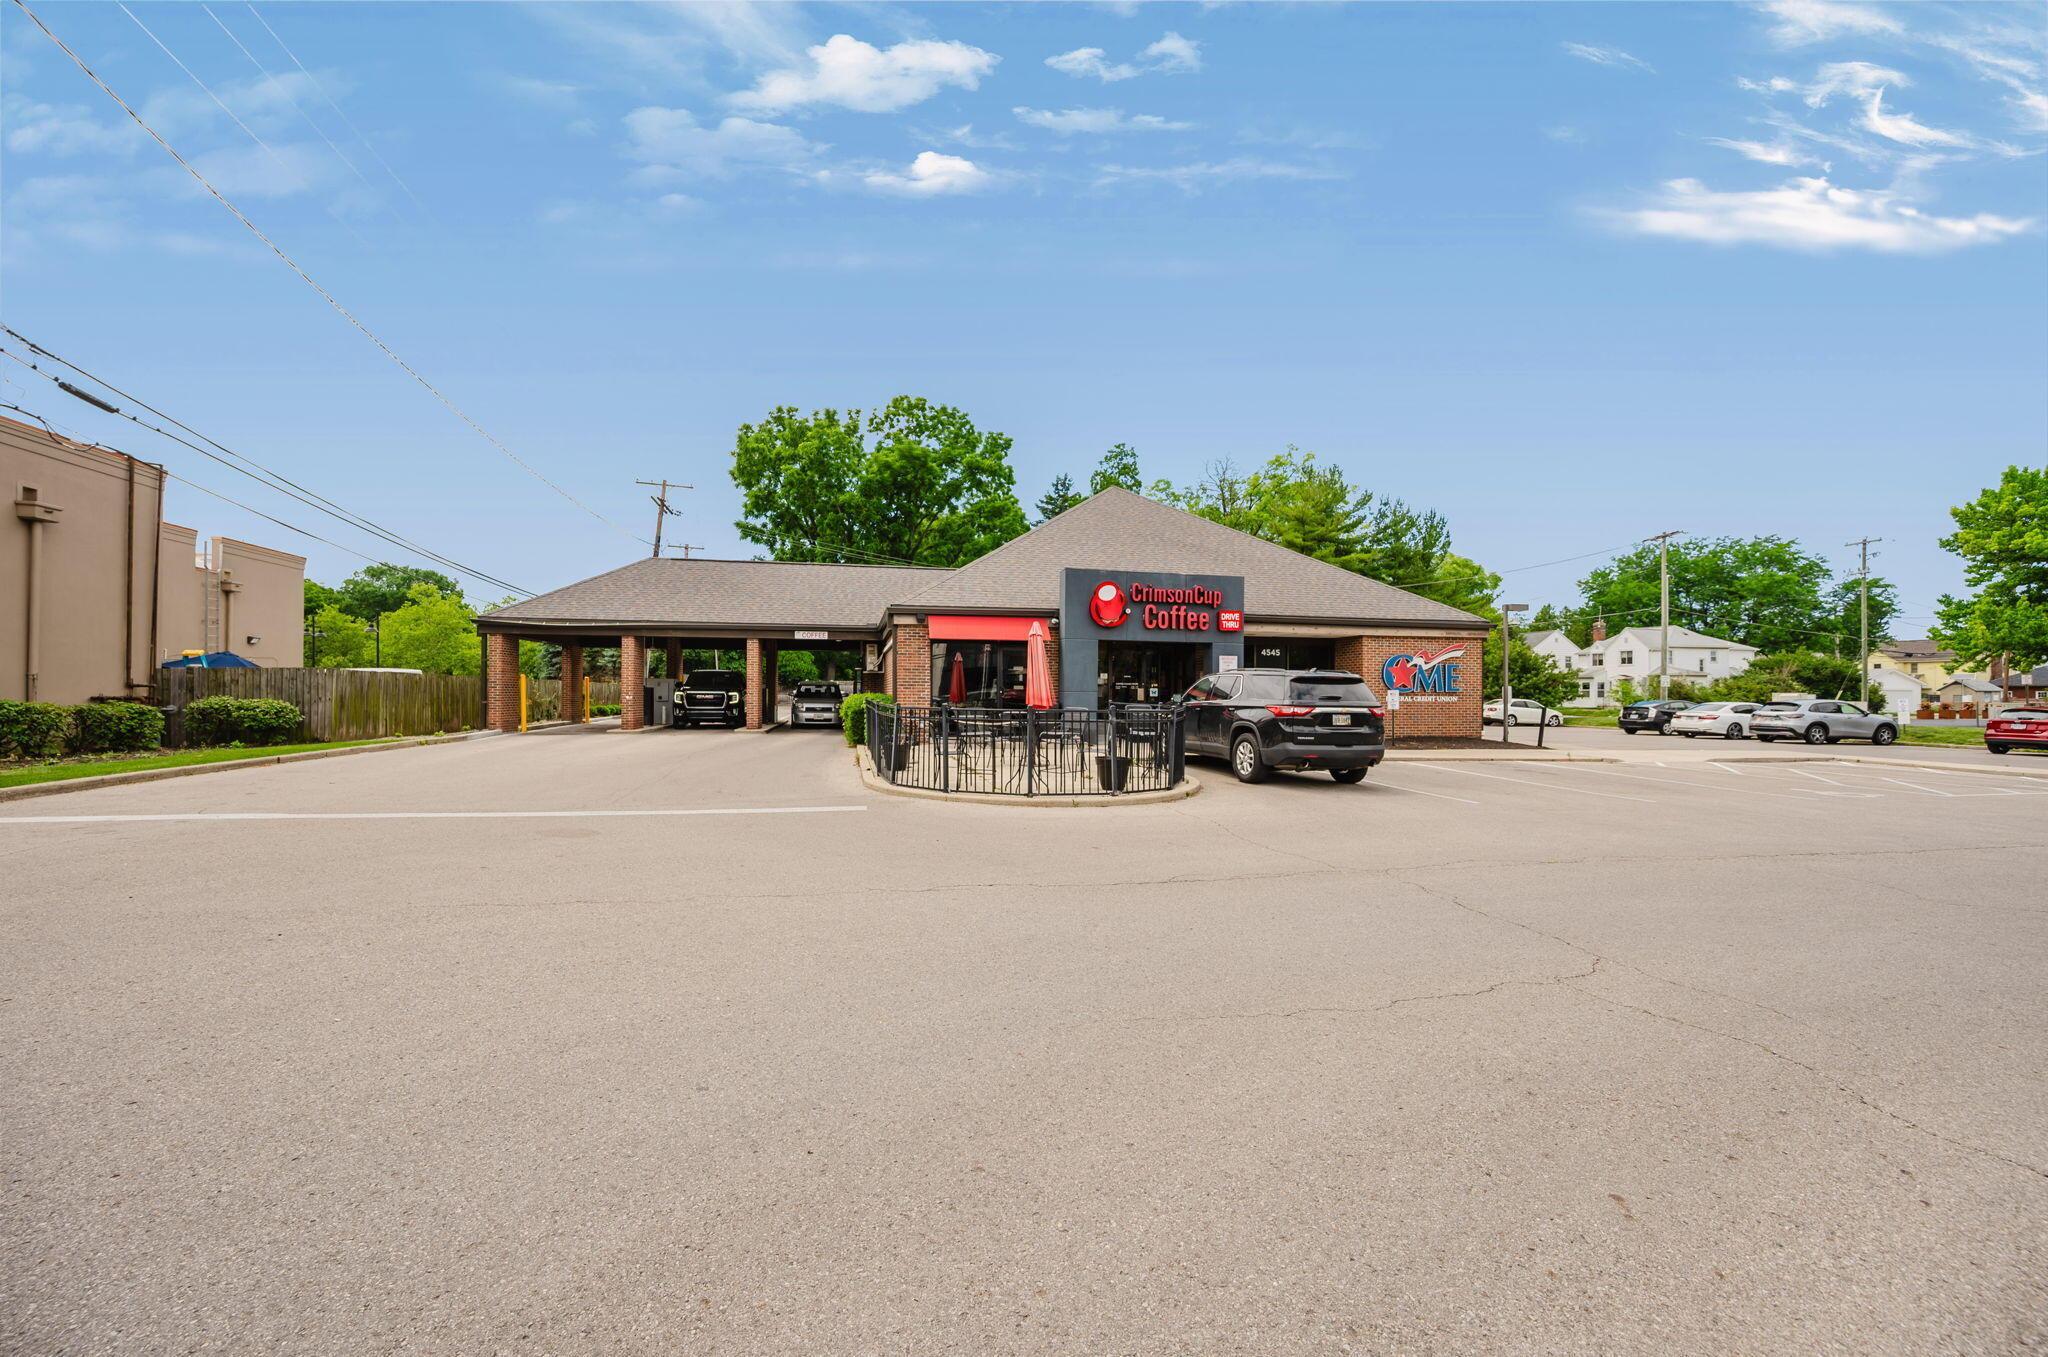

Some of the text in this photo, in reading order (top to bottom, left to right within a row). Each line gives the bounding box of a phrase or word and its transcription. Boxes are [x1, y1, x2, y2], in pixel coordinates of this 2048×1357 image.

[1144, 603, 1210, 630] Coffee
[1221, 613, 1240, 621] DRIVE
[1222, 621, 1240, 629] THRU
